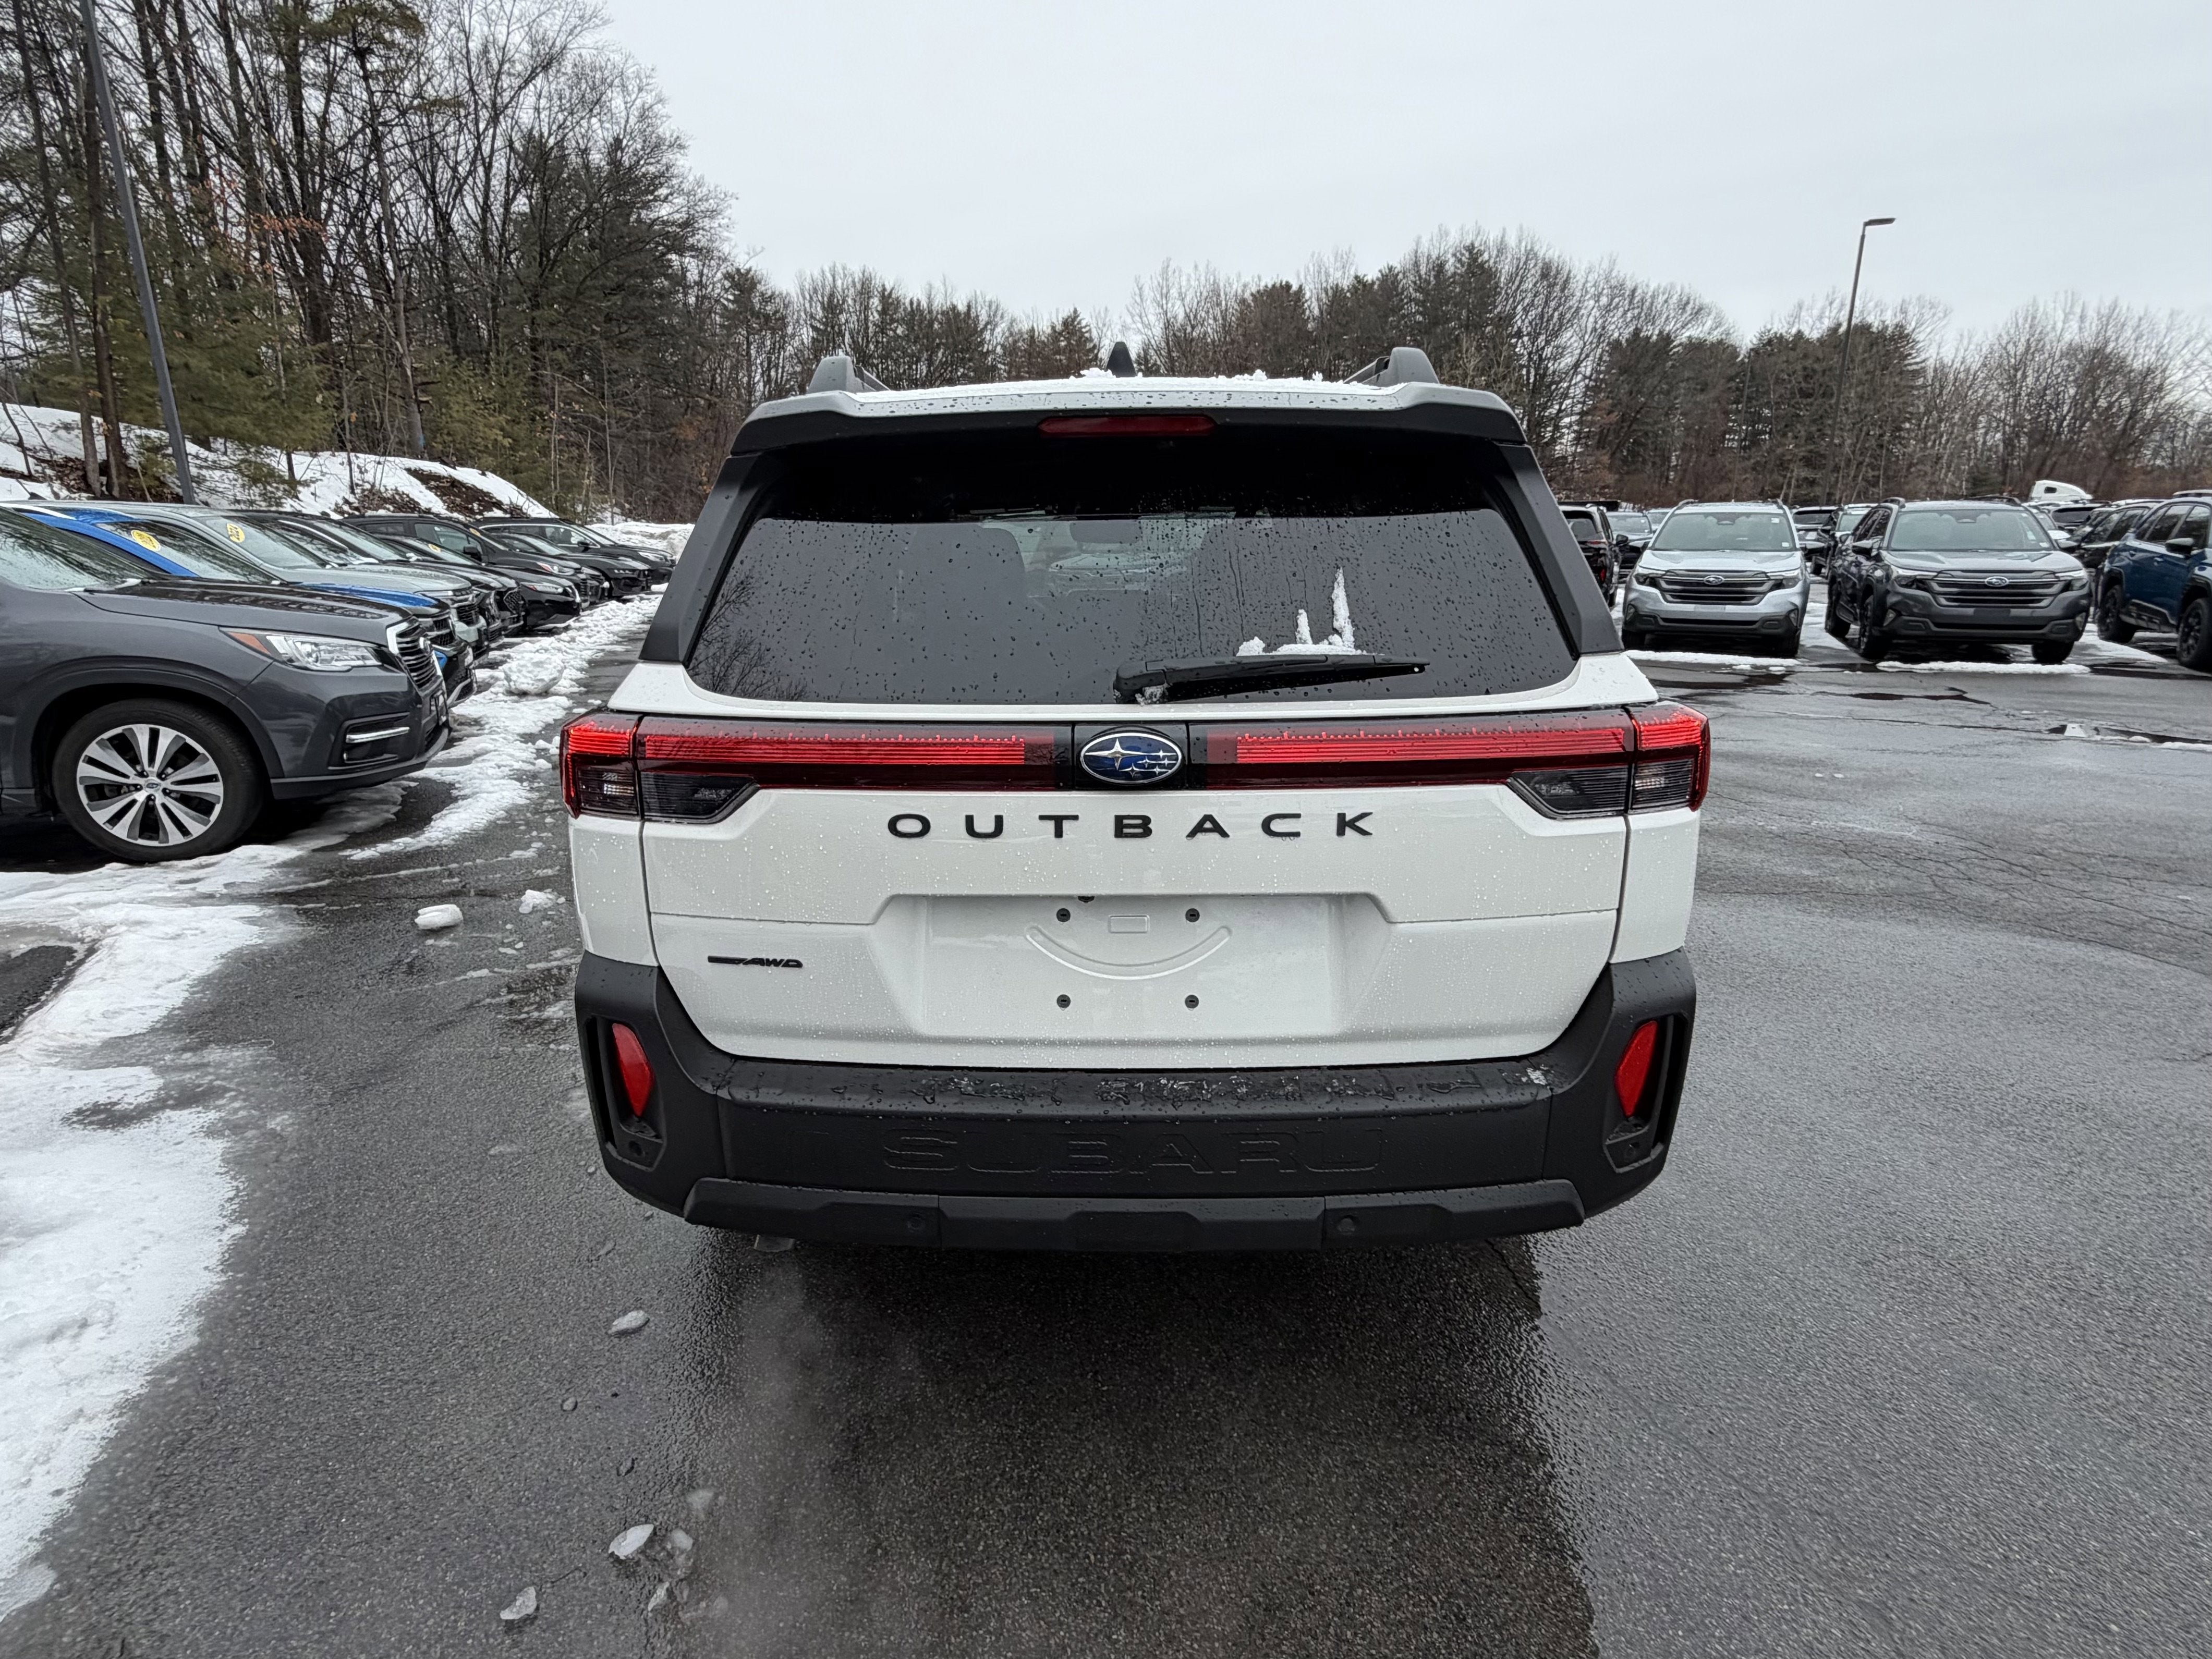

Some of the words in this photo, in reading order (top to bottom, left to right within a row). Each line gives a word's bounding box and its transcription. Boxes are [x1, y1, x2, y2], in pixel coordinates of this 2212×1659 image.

[888, 812, 1373, 839] OUTBACK
[742, 957, 803, 968] AWD
[881, 1127, 1383, 1175] SUBARU
